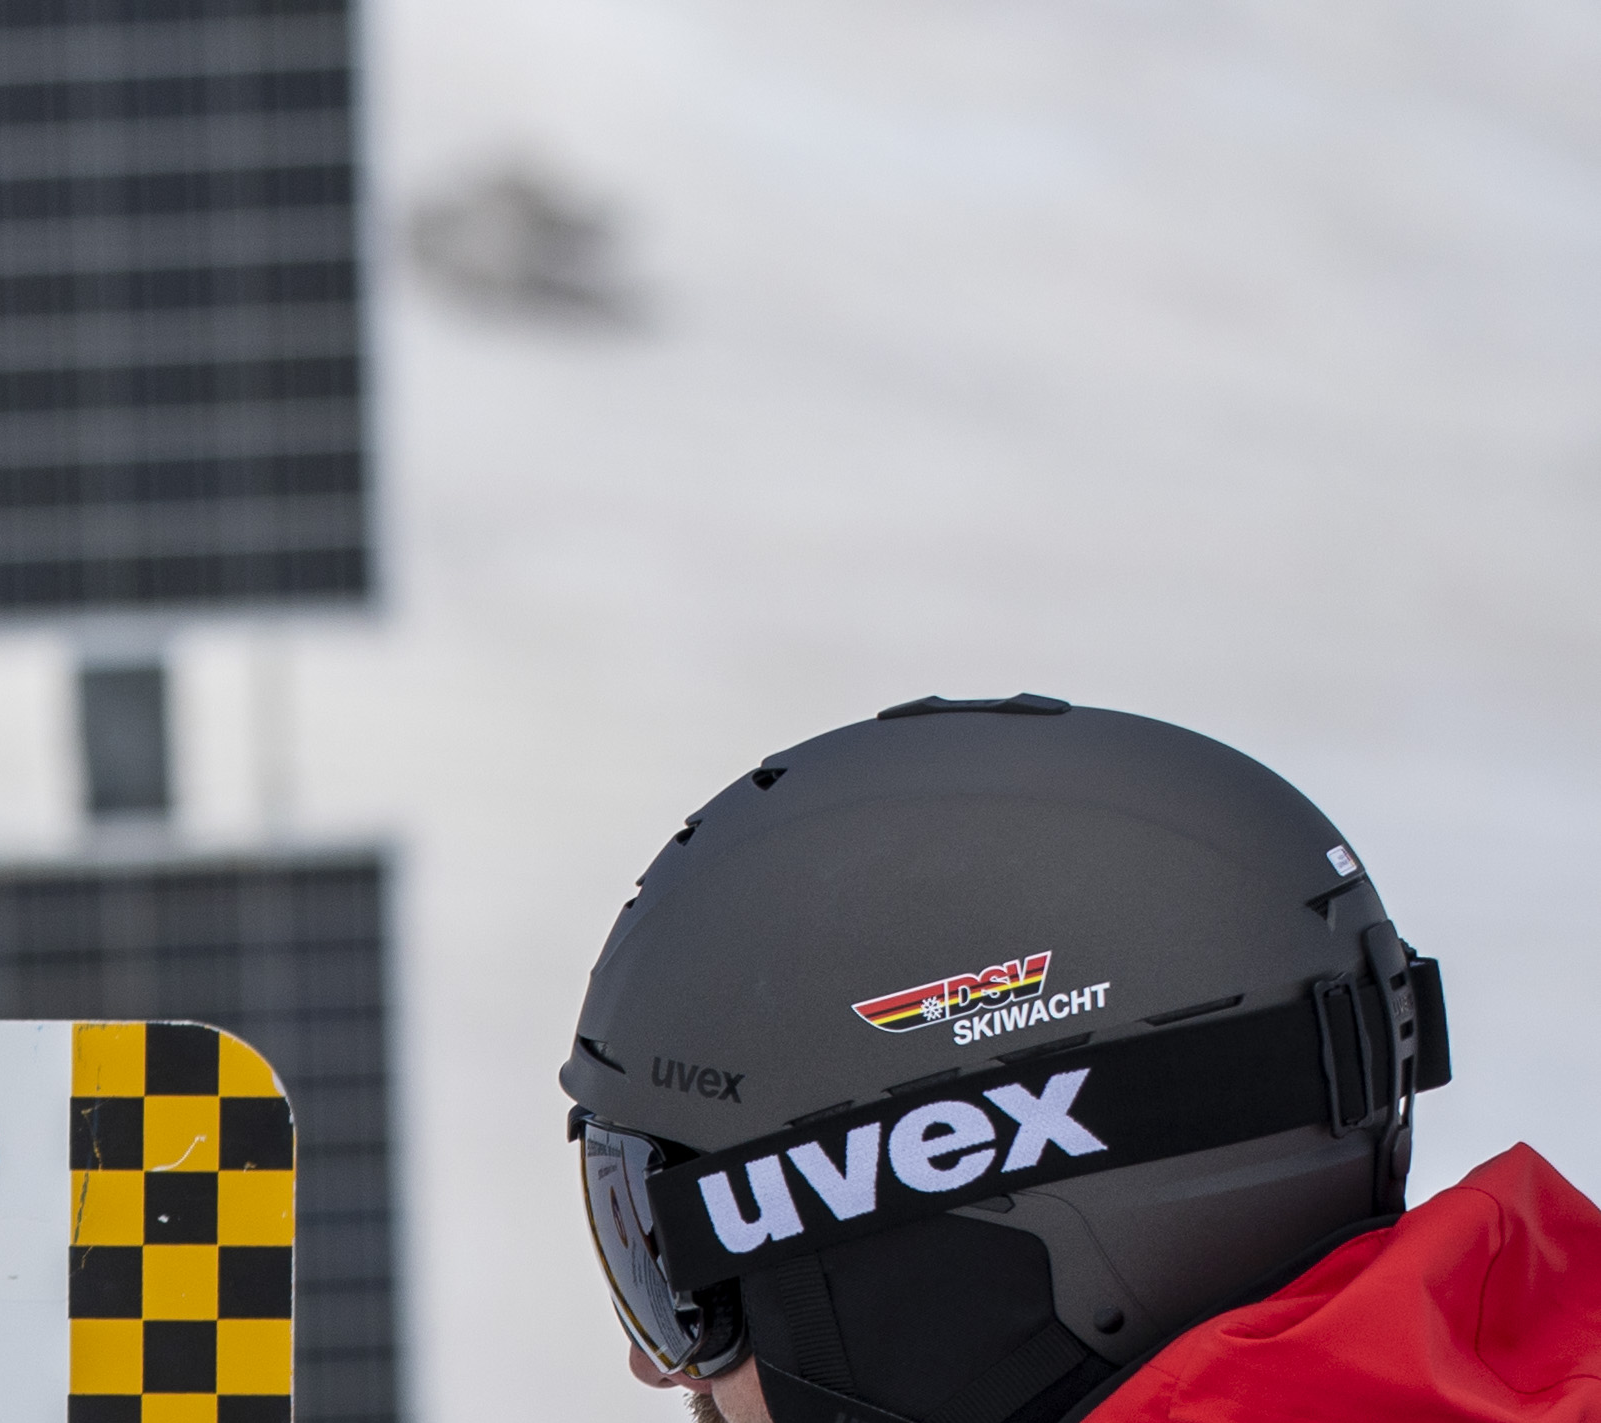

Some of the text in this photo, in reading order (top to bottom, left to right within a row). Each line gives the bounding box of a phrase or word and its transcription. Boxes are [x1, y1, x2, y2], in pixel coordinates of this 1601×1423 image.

[945, 951, 1052, 1018] DSV
[953, 982, 1111, 1046] SKIWACHT
[651, 1056, 745, 1103] uvex
[697, 1067, 1109, 1255] uvex
